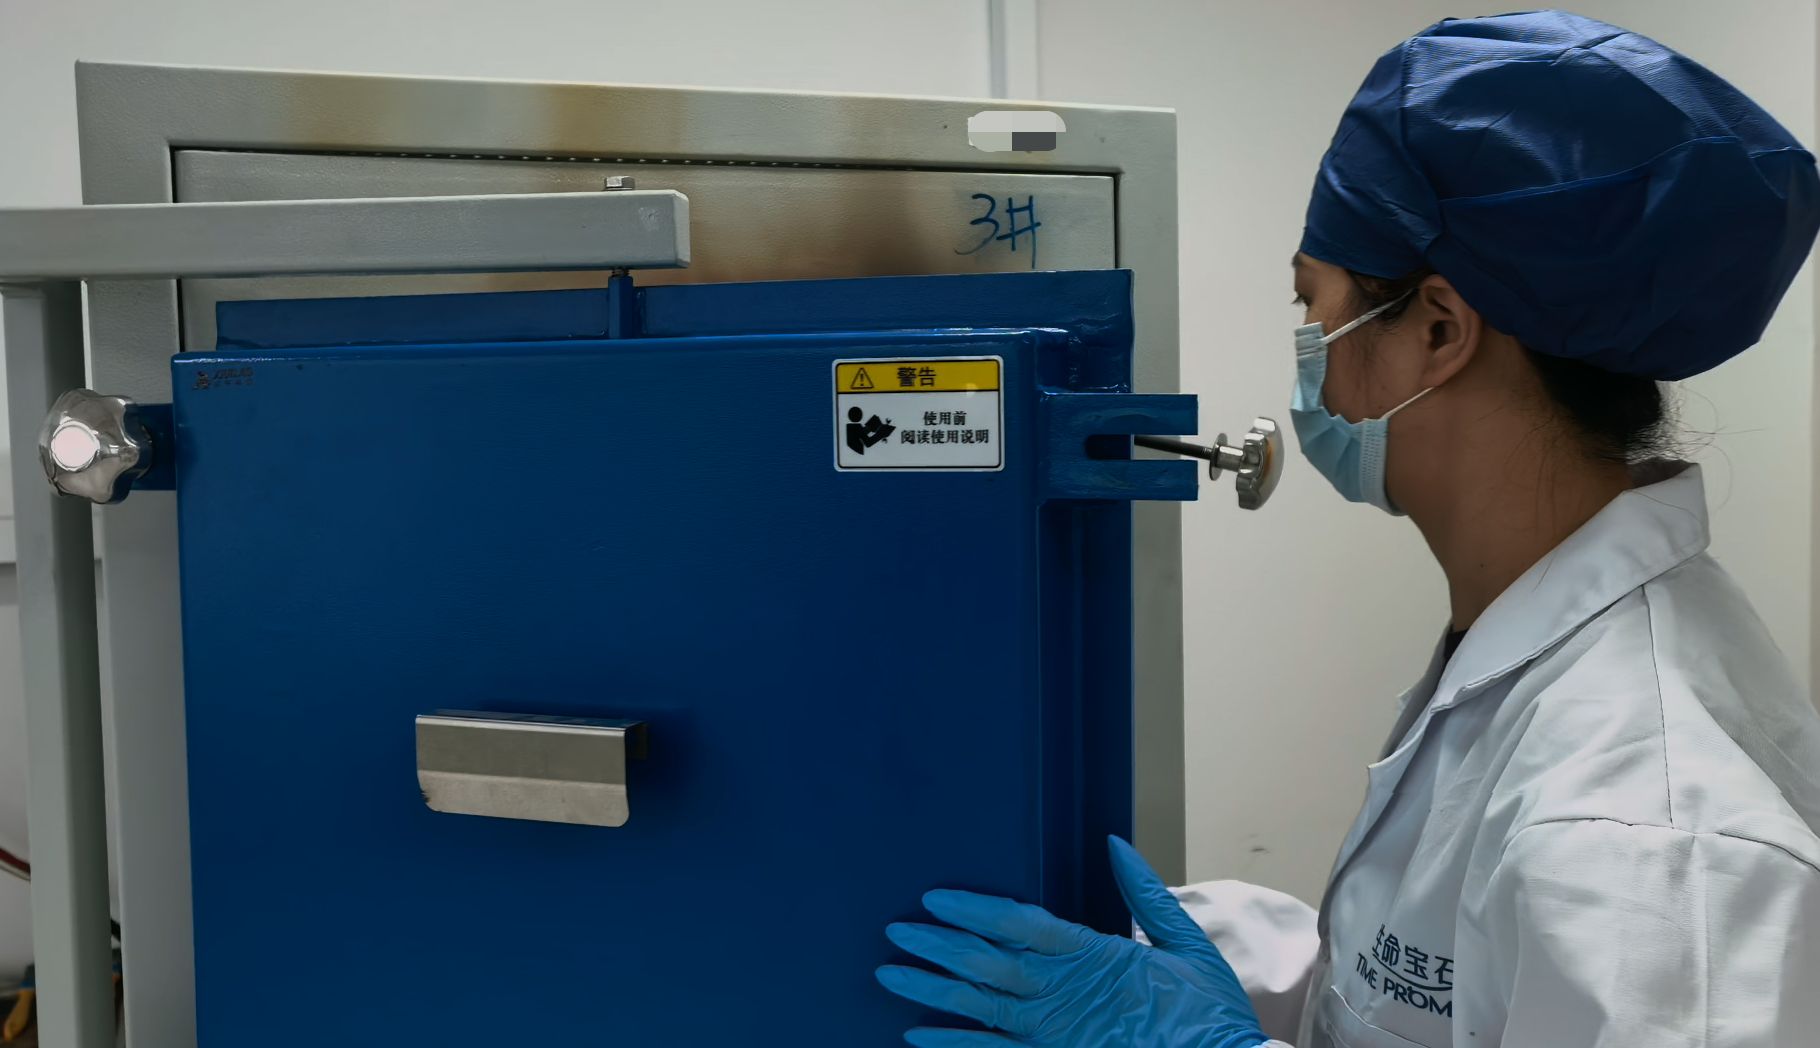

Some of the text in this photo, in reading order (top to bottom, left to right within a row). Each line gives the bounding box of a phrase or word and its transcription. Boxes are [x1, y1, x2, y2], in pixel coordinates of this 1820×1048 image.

[954, 193, 1042, 269] 3#
[897, 366, 937, 387] 警告
[923, 411, 968, 426] 使用前
[900, 429, 990, 445] 阅读使用说明
[1356, 952, 1379, 990] TIME
